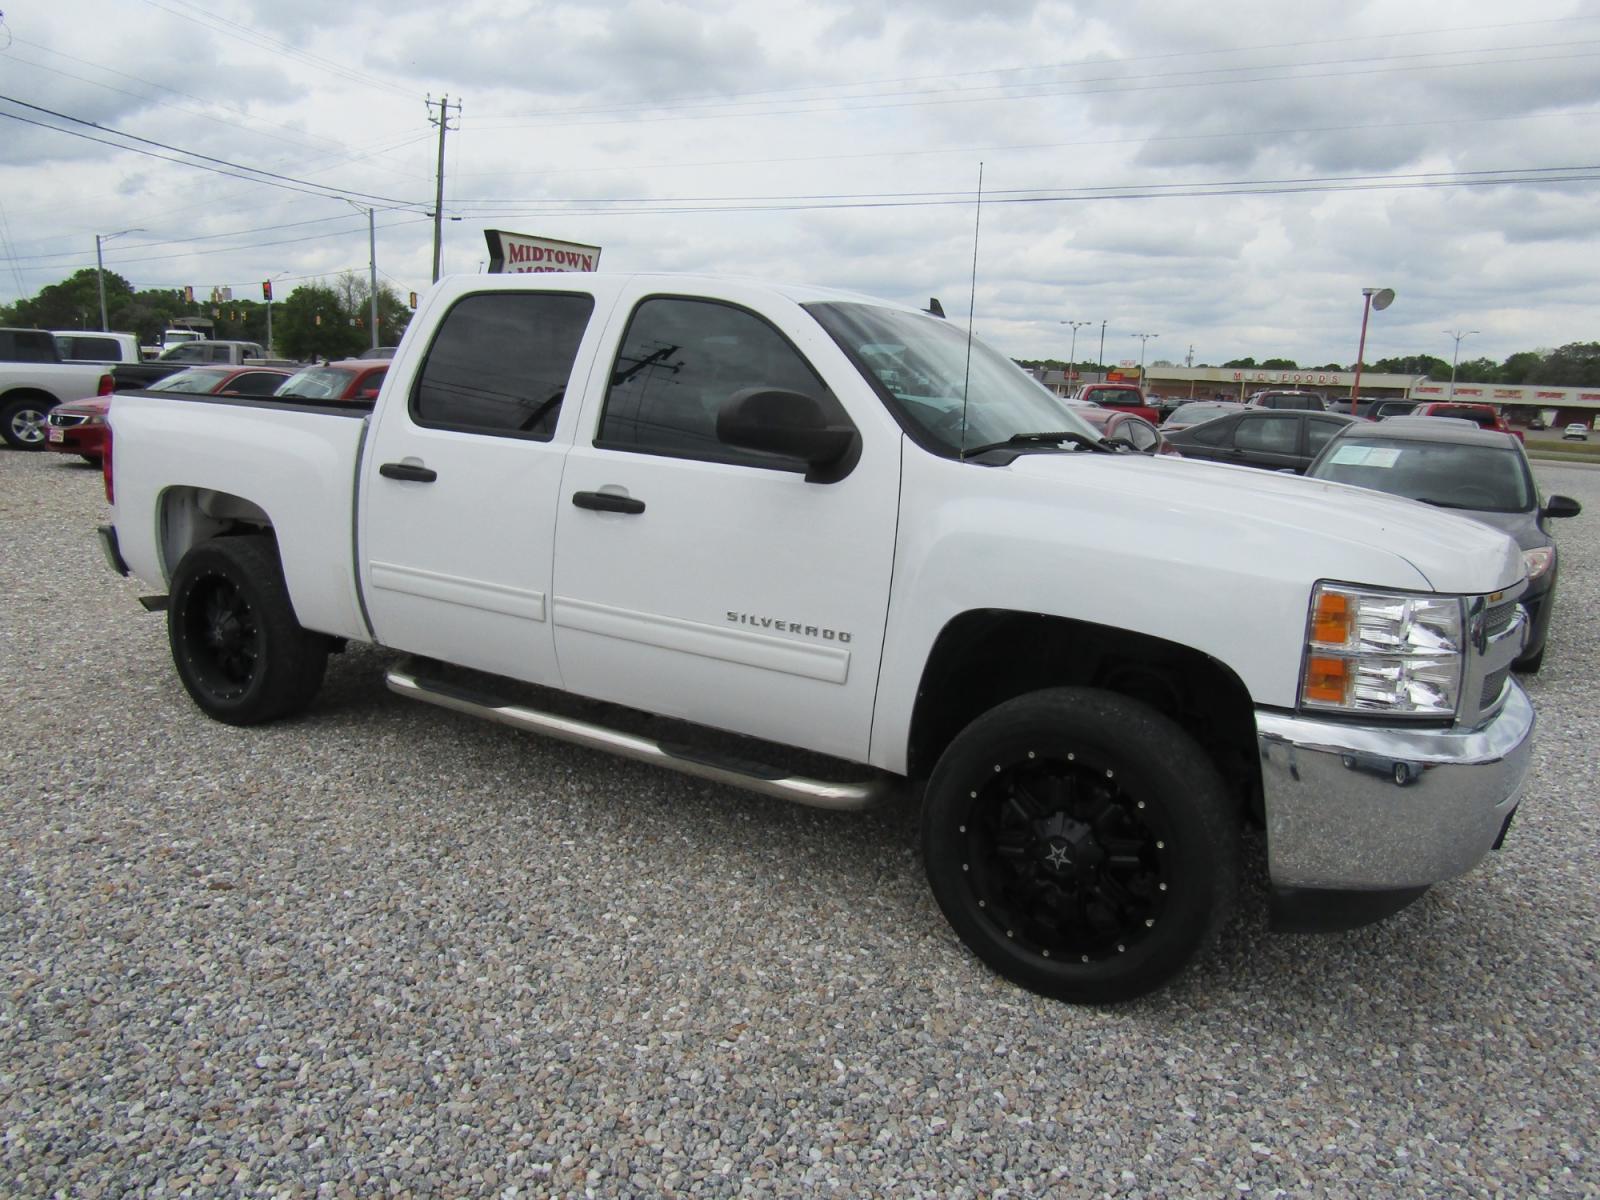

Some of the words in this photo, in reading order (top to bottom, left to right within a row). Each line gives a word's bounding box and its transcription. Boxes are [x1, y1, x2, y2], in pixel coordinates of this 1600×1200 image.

[508, 242, 593, 272] MIDTOWN
[1281, 373, 1339, 384] FOODS
[726, 611, 852, 643] SILVERADO
